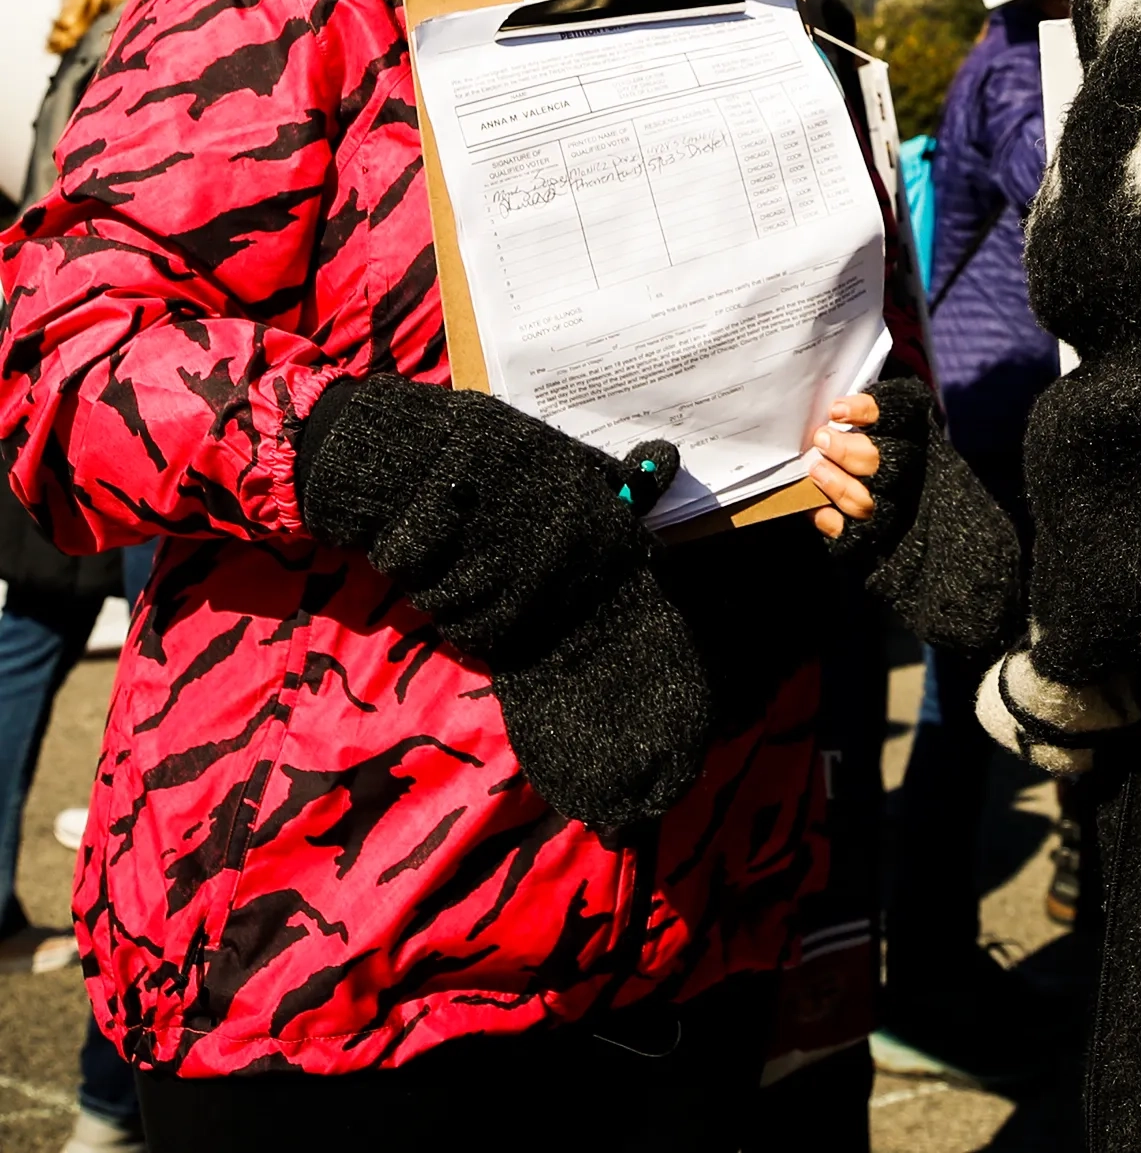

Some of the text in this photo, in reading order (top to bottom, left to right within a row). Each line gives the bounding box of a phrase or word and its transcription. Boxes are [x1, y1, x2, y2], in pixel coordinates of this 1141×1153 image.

[480, 117, 507, 130] ANNA
[522, 100, 570, 118] VALENCIA
[567, 136, 596, 148] PRINTED
[598, 130, 615, 139] NAME
[810, 131, 831, 141] ILLINOIS
[570, 136, 629, 157] QUALIFIED VOTER
[740, 138, 766, 149] CHICAGO
[783, 141, 798, 149] COOK
[491, 152, 529, 168] SIGNATURE
[744, 149, 769, 161] CHICAGO
[786, 153, 801, 161] COOK
[488, 164, 524, 179] QUALIFIED
[525, 157, 549, 168] VOTER
[747, 161, 773, 173] CHICAGO
[789, 164, 804, 172] COOK
[750, 172, 775, 184] CHICAGO
[752, 184, 778, 196] CHICAGO
[756, 196, 782, 208] CHICAGO
[760, 208, 785, 220] CHICAGO
[763, 219, 788, 232] CHICAGO
[780, 284, 798, 292] County
[518, 319, 540, 332] STATE
[542, 316, 551, 324] OF
[521, 316, 583, 341] COUNTY OF COOK
